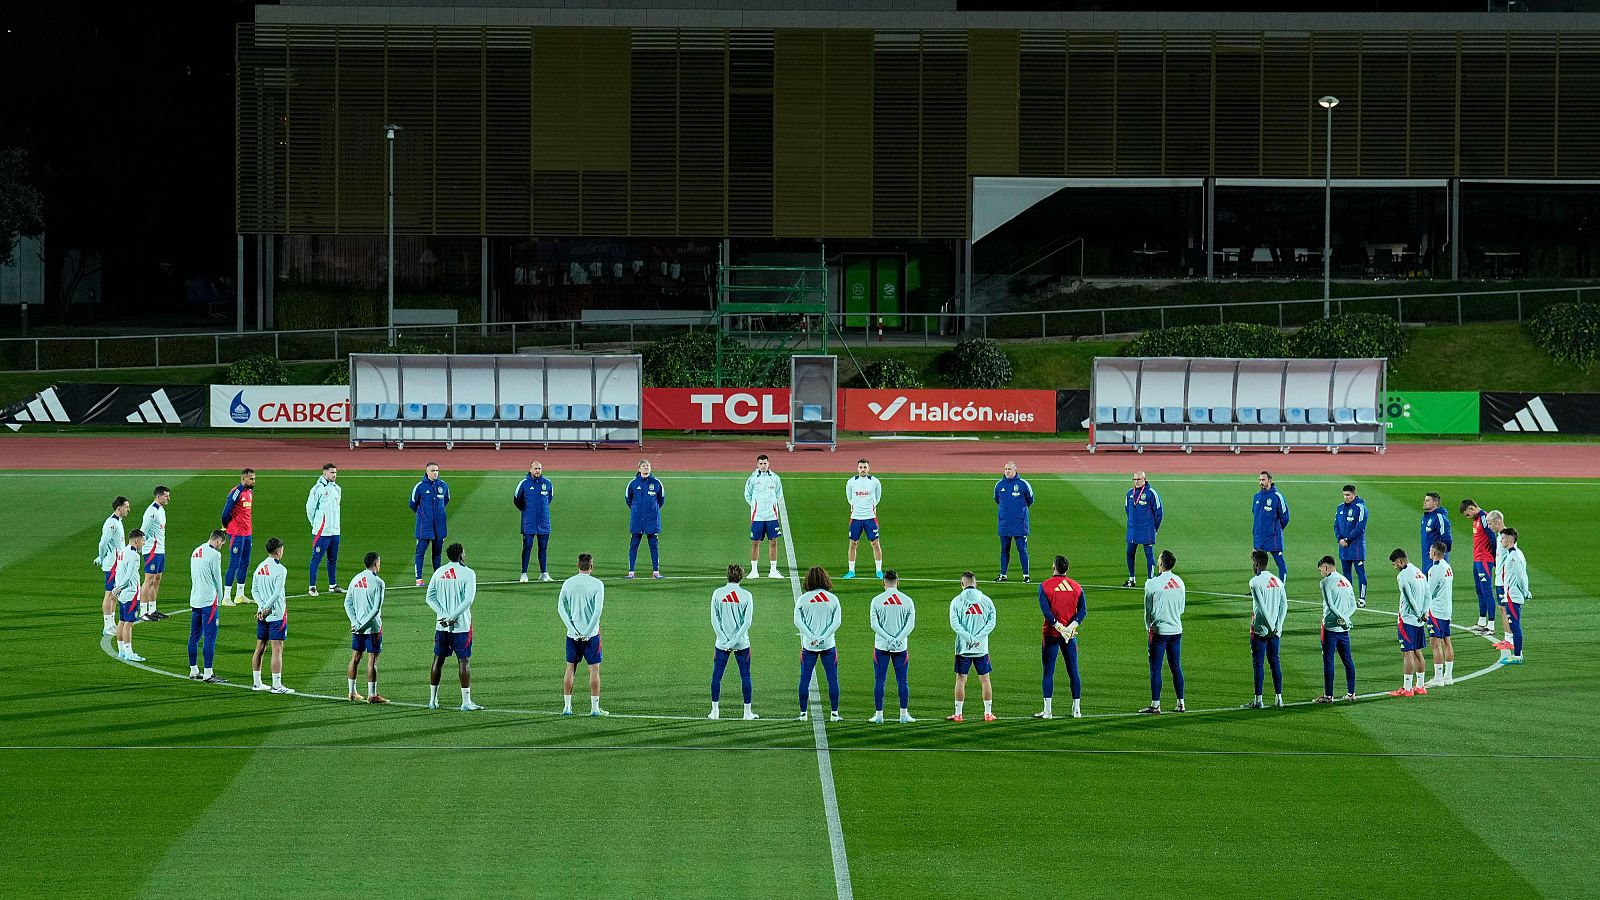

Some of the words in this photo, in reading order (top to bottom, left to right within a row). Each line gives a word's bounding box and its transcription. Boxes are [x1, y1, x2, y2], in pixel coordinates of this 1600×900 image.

[690, 393, 789, 425] TCL
[909, 401, 993, 422] Halcón
[994, 409, 1035, 424] viajes
